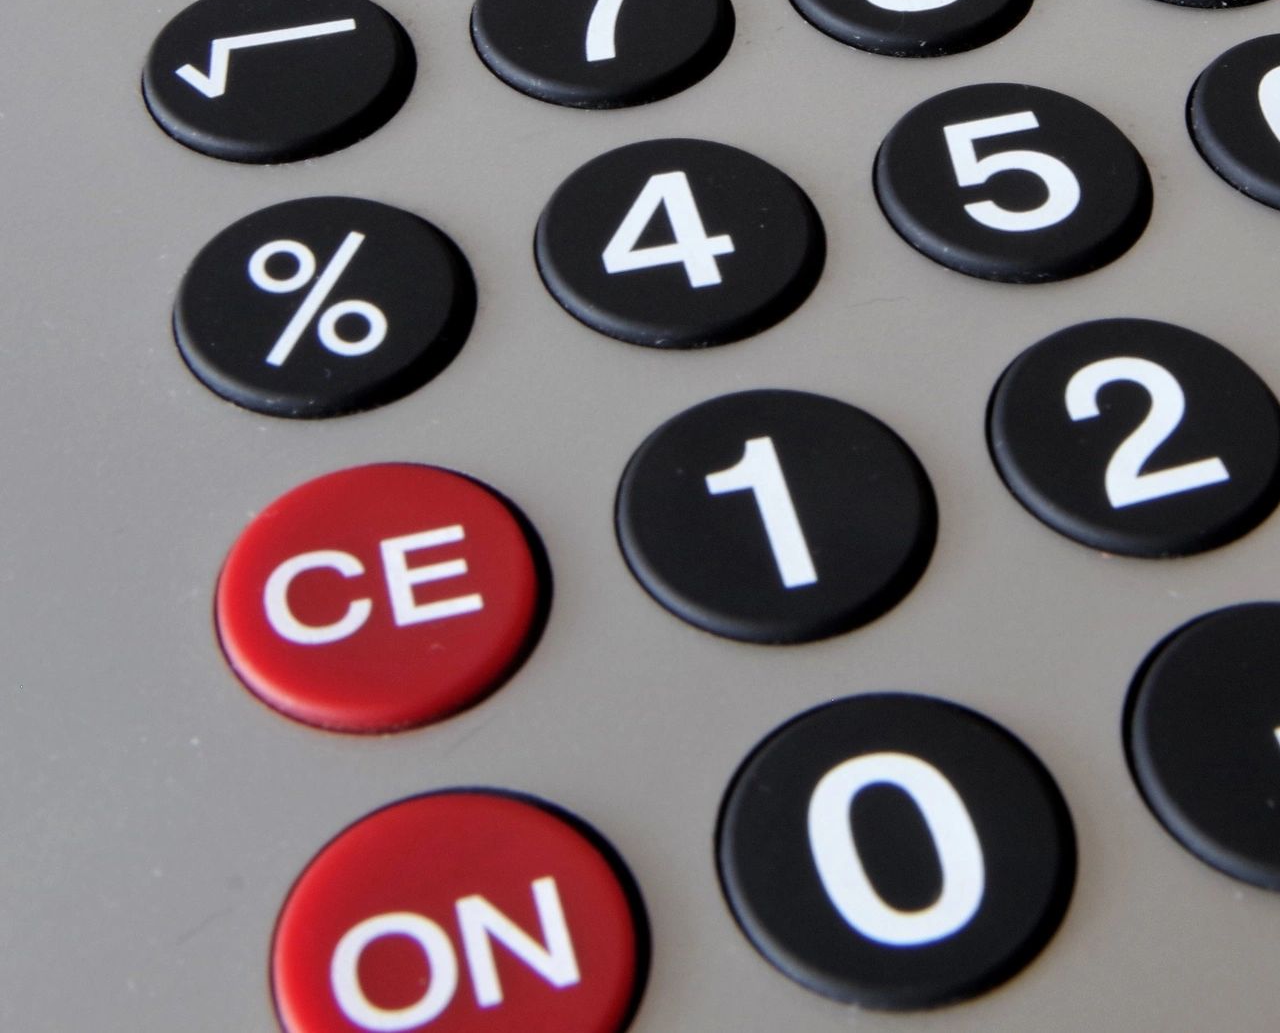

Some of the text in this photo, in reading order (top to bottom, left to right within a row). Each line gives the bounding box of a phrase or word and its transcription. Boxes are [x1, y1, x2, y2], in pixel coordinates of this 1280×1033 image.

[603, 172, 734, 287] 4
[944, 111, 1080, 231] 5
[249, 232, 387, 366] %
[1066, 357, 1229, 508] 2
[706, 437, 817, 587] 1
[264, 526, 483, 644] CE
[808, 753, 984, 943] 0
[331, 879, 580, 1030] ON
